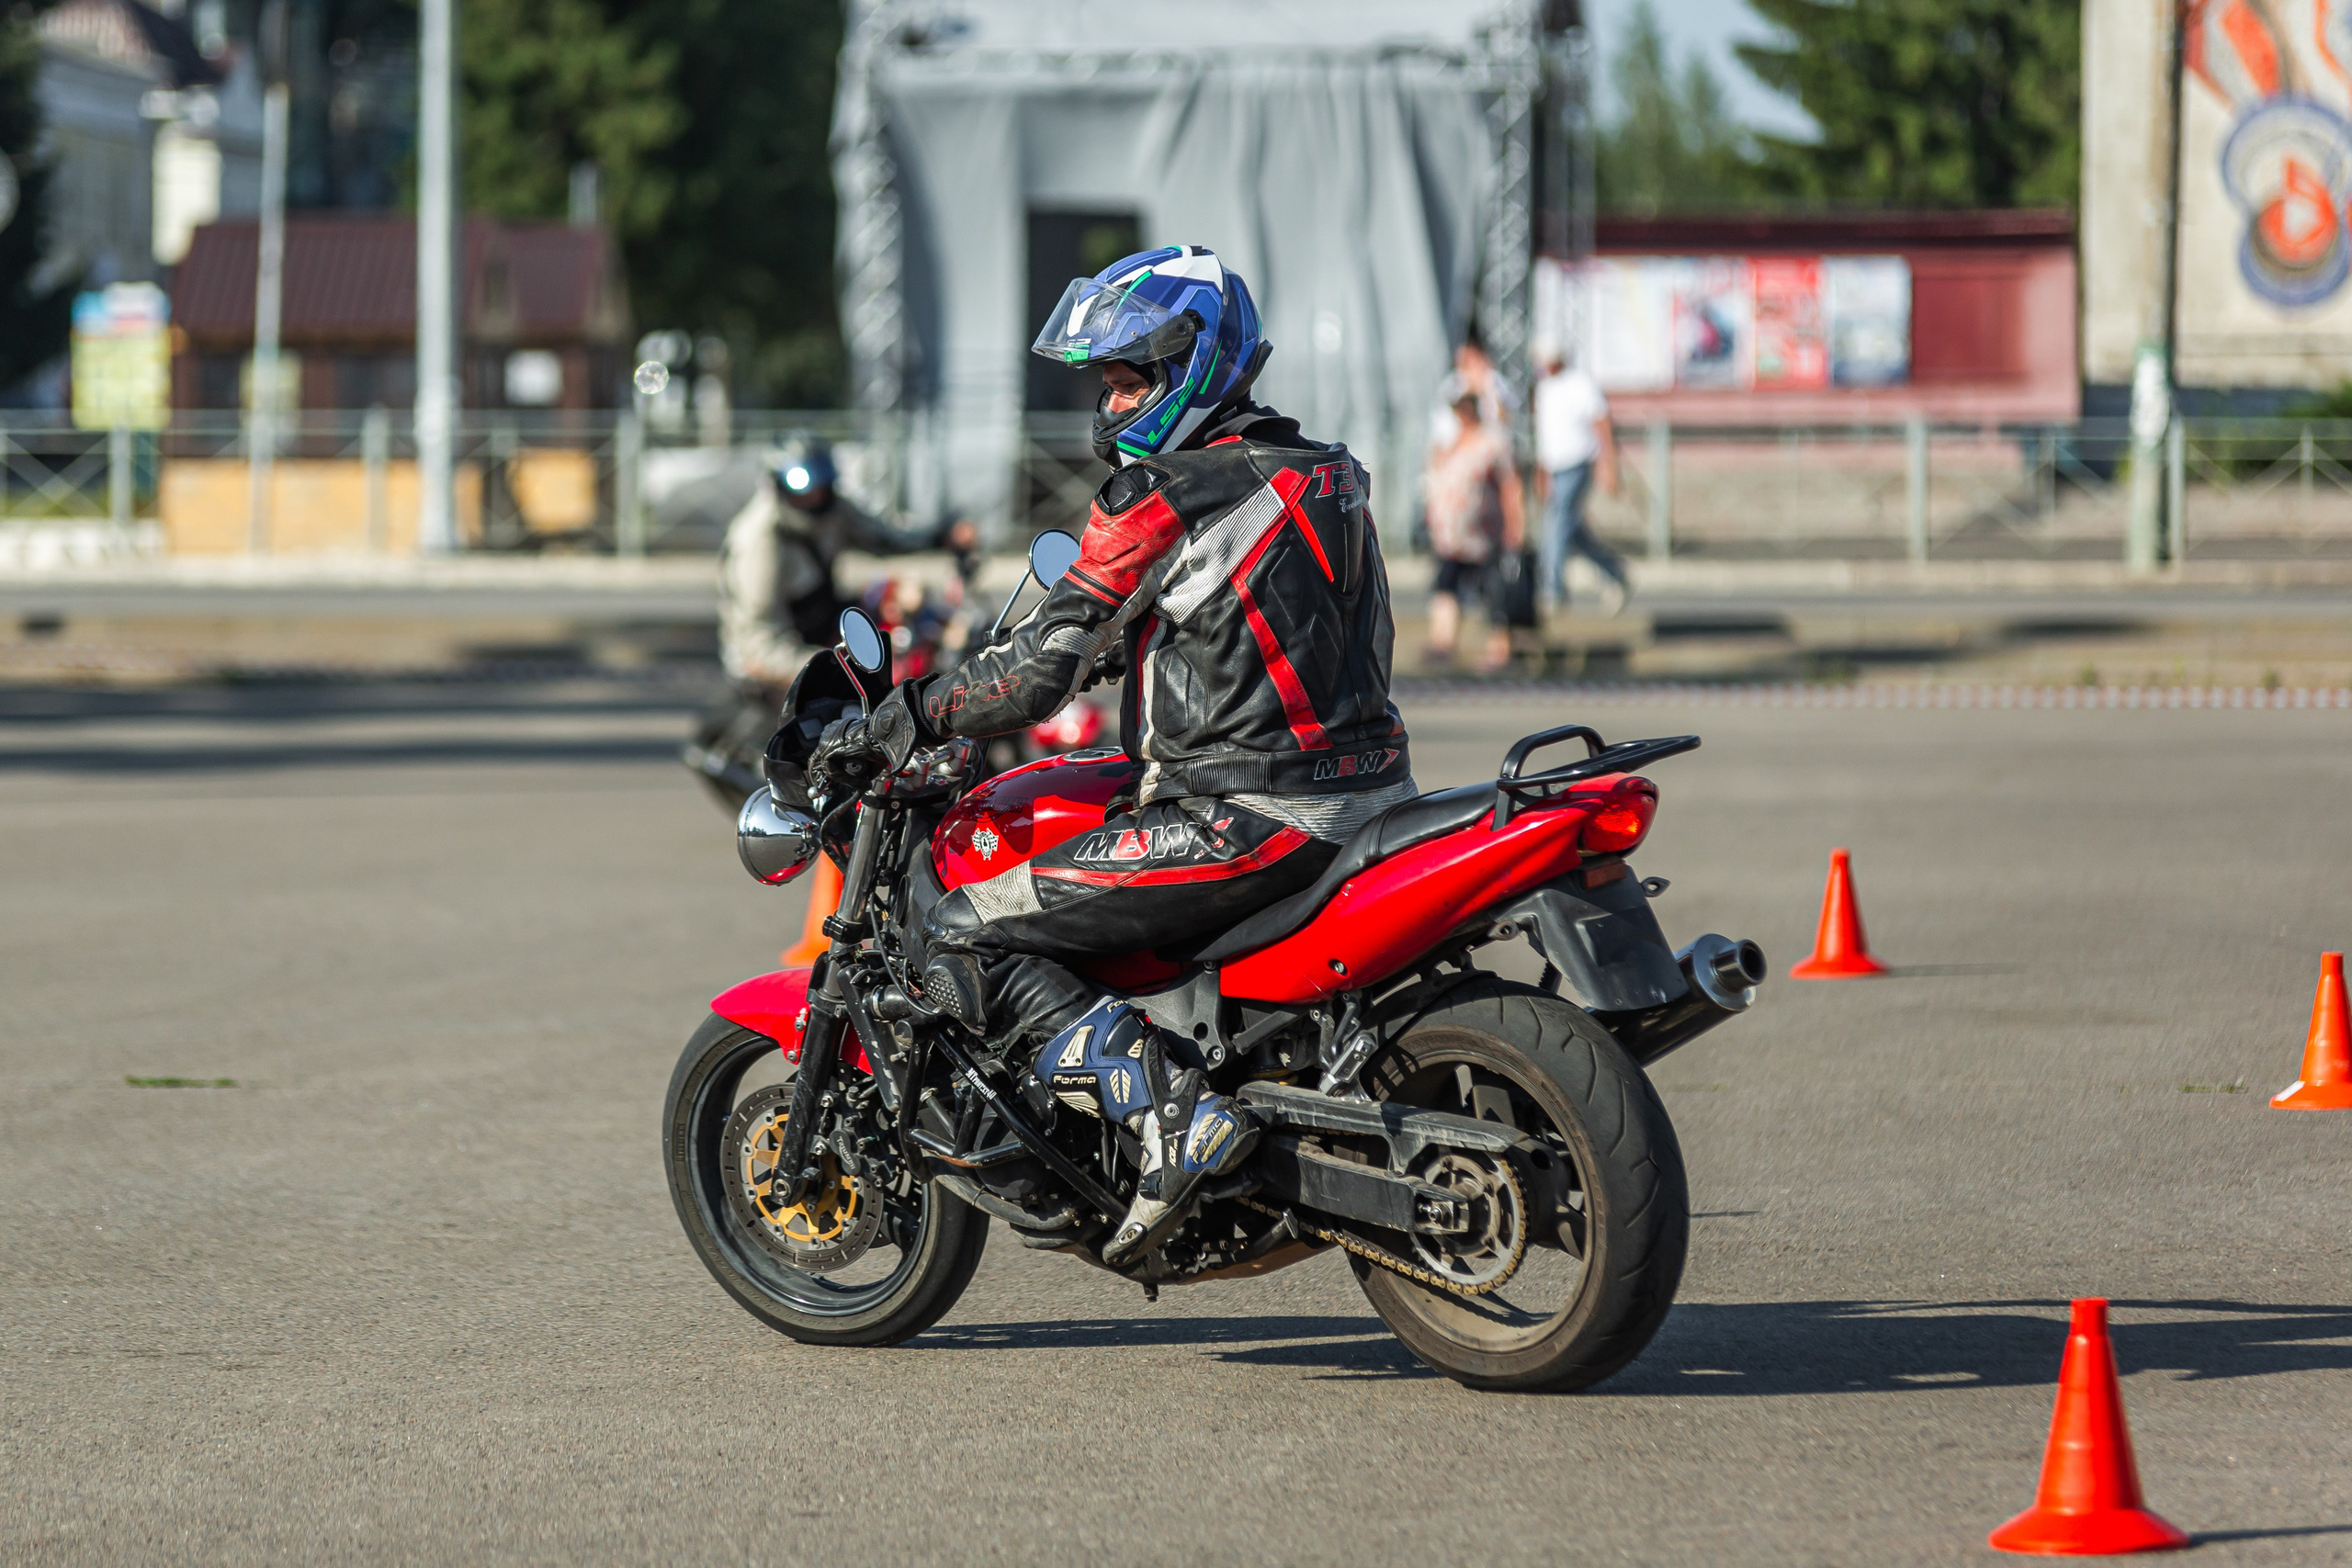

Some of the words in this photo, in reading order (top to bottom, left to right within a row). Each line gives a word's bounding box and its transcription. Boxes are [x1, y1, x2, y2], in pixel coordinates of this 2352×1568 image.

[1148, 377, 1196, 445] LS2
[1313, 461, 1355, 498] T3
[1314, 750, 1382, 780] MBW
[1073, 822, 1202, 862] MBW
[1053, 1075, 1097, 1085] Forma
[837, 1135, 856, 1169] TRIUMPH
